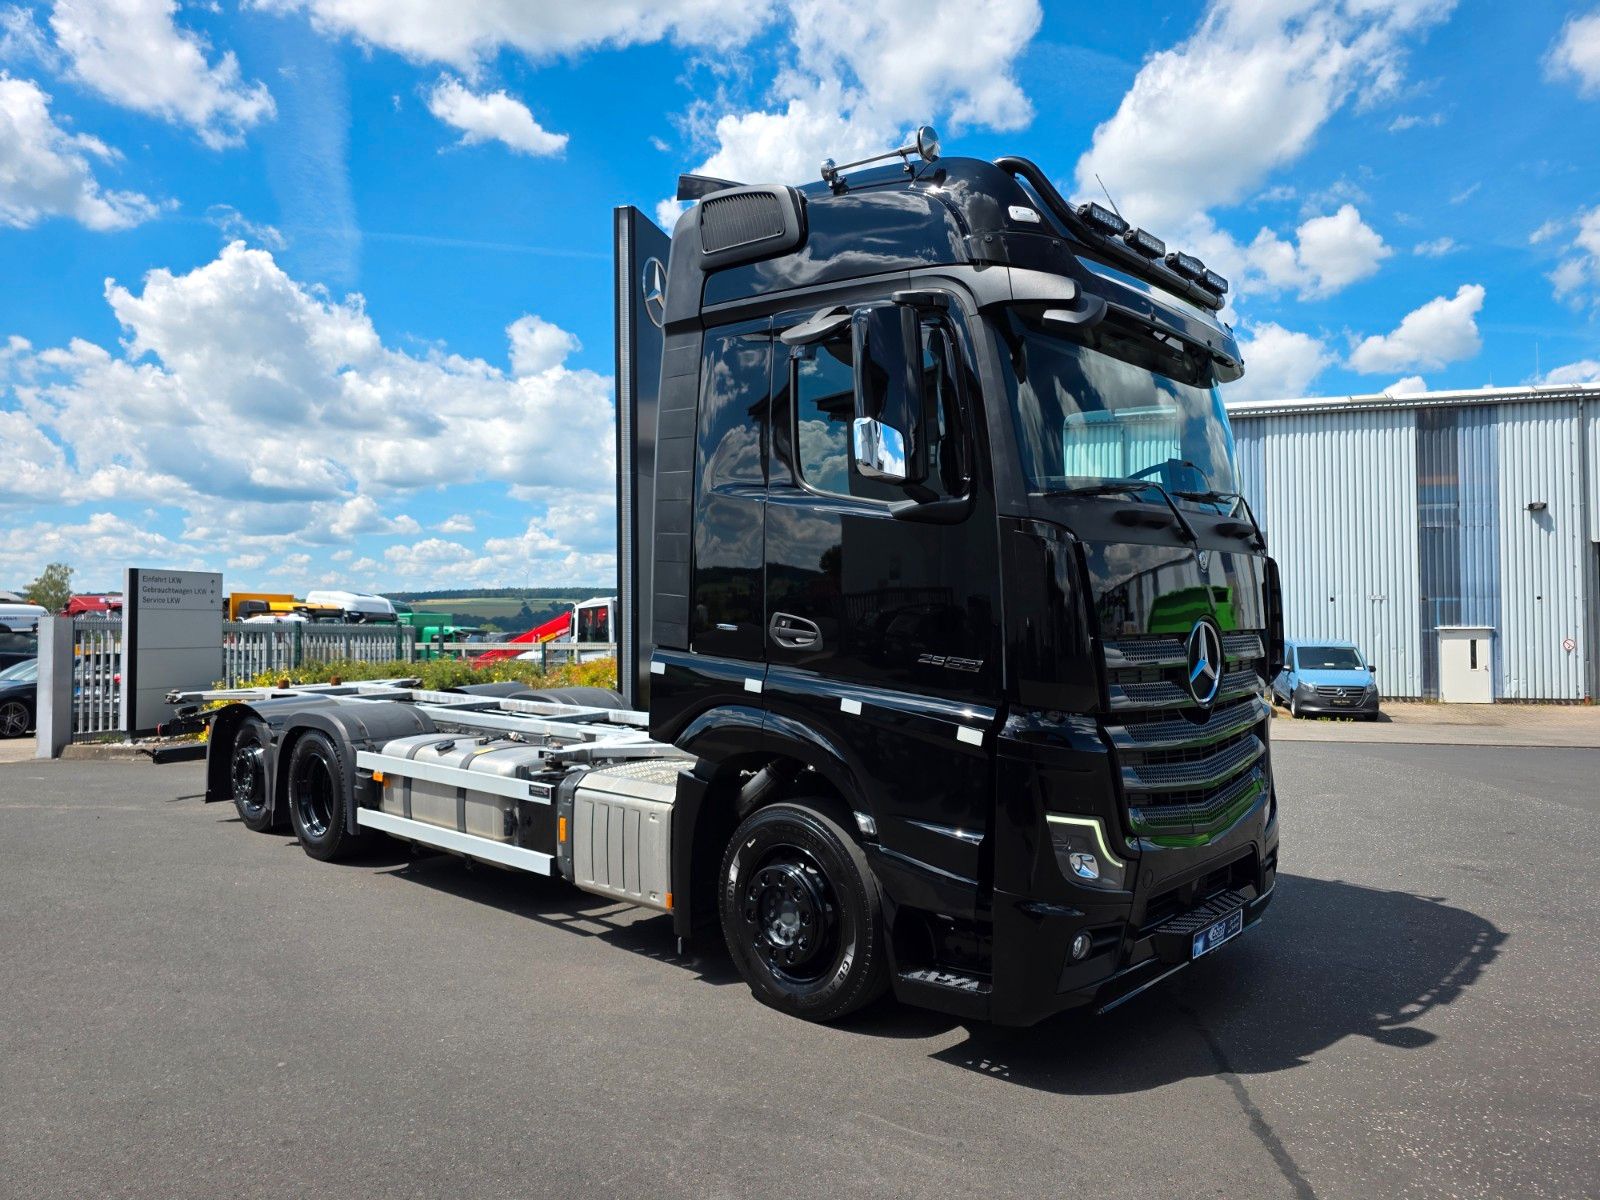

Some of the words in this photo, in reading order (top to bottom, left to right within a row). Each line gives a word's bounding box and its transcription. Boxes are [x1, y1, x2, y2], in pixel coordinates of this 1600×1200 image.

[142, 575, 167, 583] Einfahrt
[168, 576, 182, 584] LKW
[142, 585, 193, 595] Gebrauchtwagen
[142, 596, 166, 604] Service
